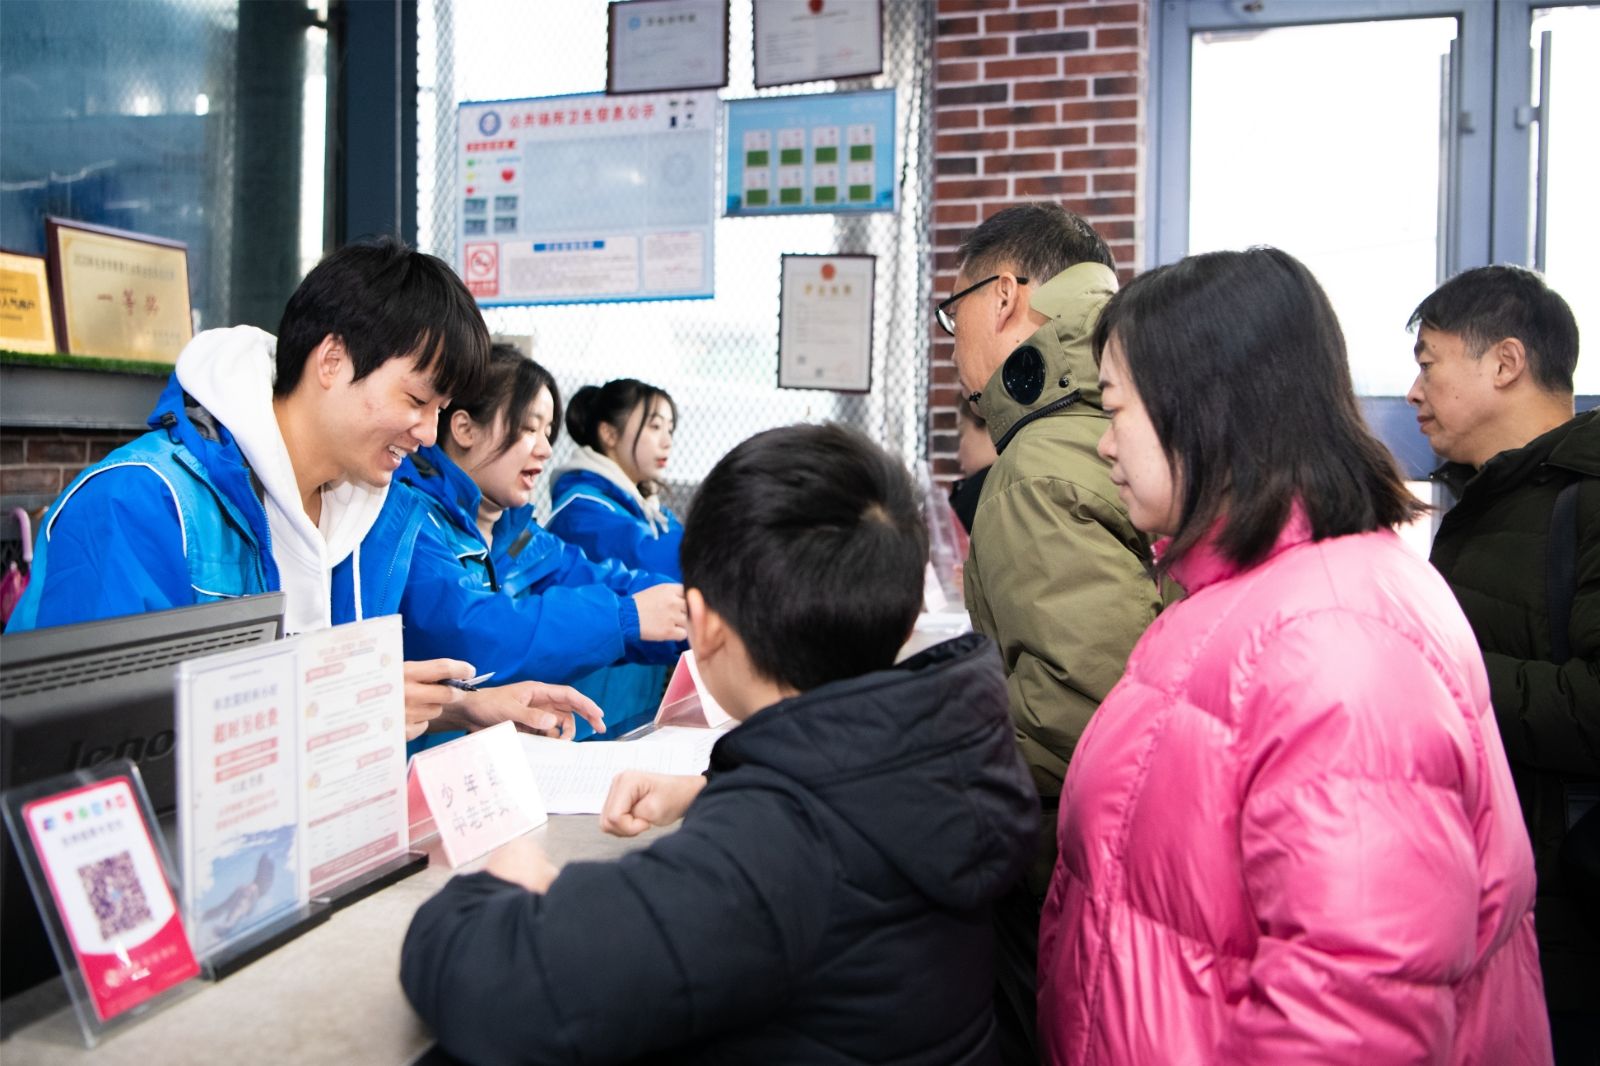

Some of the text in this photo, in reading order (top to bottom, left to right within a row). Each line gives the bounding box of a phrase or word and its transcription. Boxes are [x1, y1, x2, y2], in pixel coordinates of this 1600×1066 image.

[509, 103, 656, 129] 公共场所卫生信息公示
[97, 287, 160, 317] 一等奖
[66, 729, 176, 770] leno
